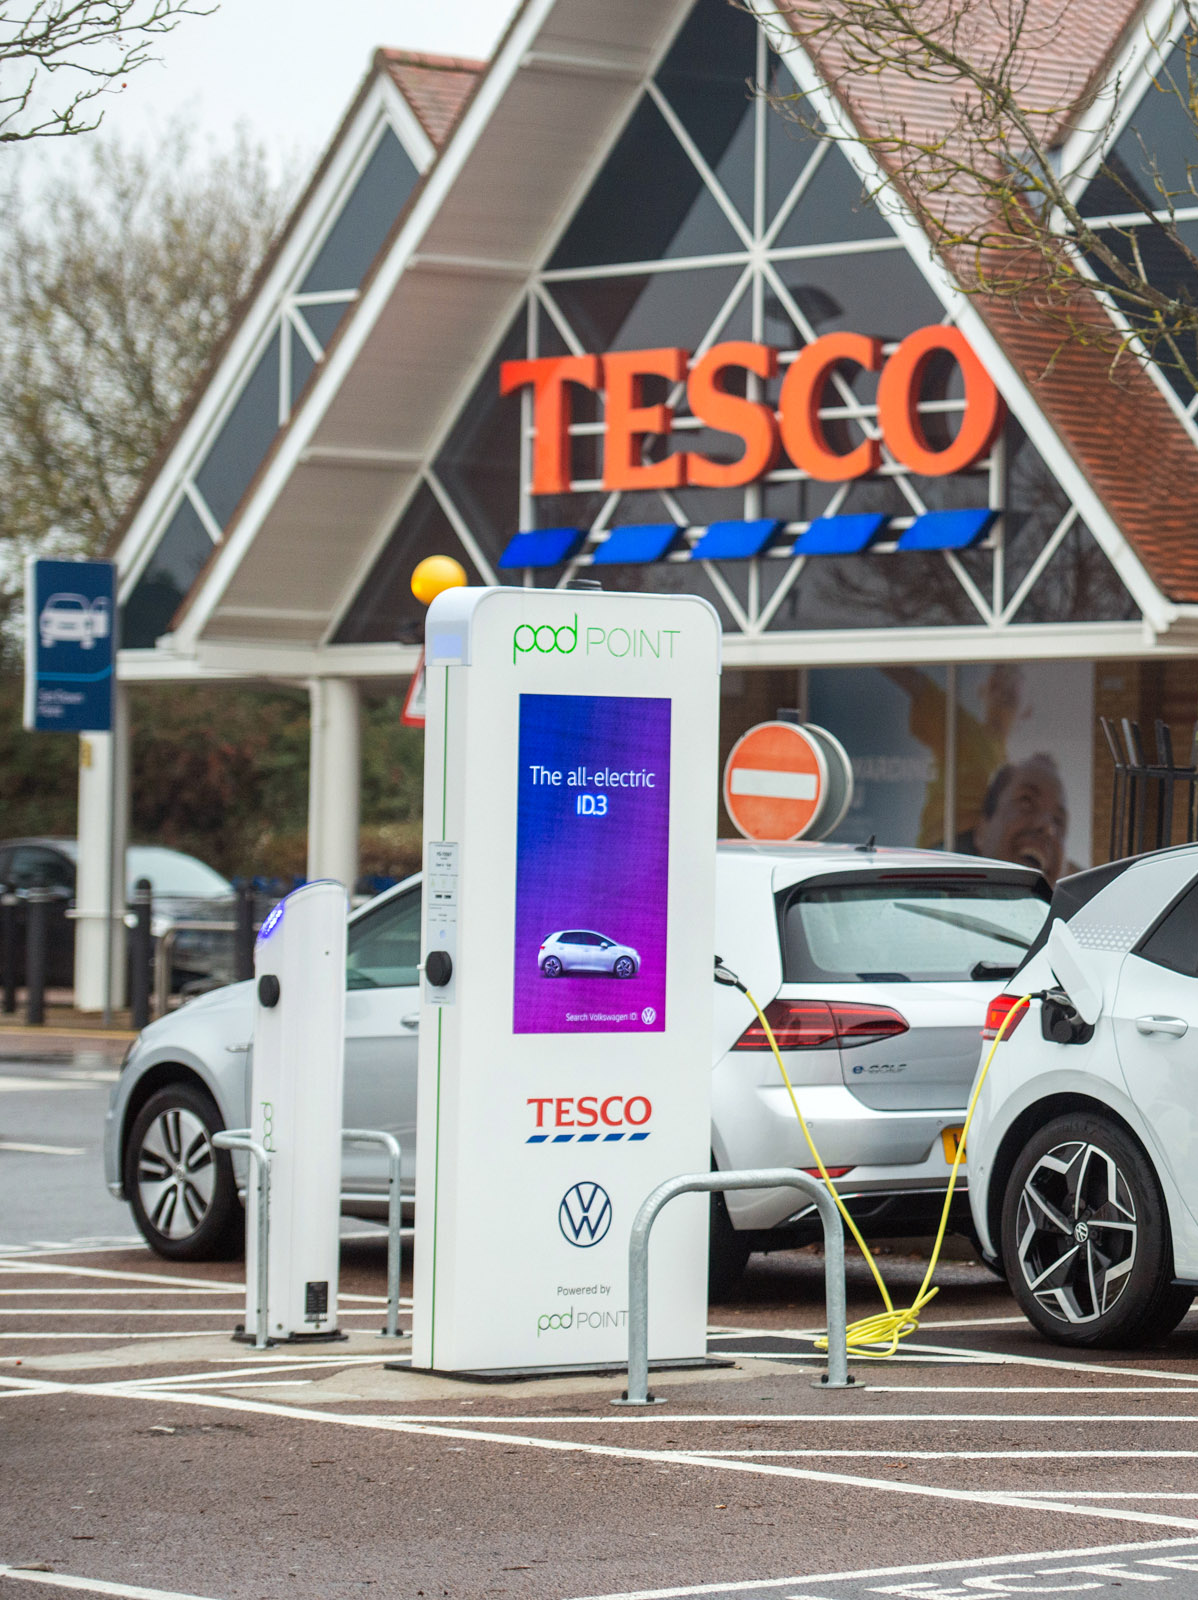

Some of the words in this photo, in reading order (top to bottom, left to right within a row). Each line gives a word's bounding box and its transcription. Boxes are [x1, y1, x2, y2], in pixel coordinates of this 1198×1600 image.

[499, 324, 999, 496] TESCO
[513, 612, 578, 665] pod
[586, 626, 681, 659] POINT
[529, 765, 562, 787] The
[566, 765, 656, 789] all-electric
[576, 794, 608, 816] ID.3
[566, 1012, 587, 1022] Search
[589, 1012, 628, 1023] Volkswagen
[526, 1095, 653, 1128] TESCO
[557, 1284, 597, 1297] Powered
[599, 1283, 612, 1298] by
[537, 1306, 574, 1338] pod
